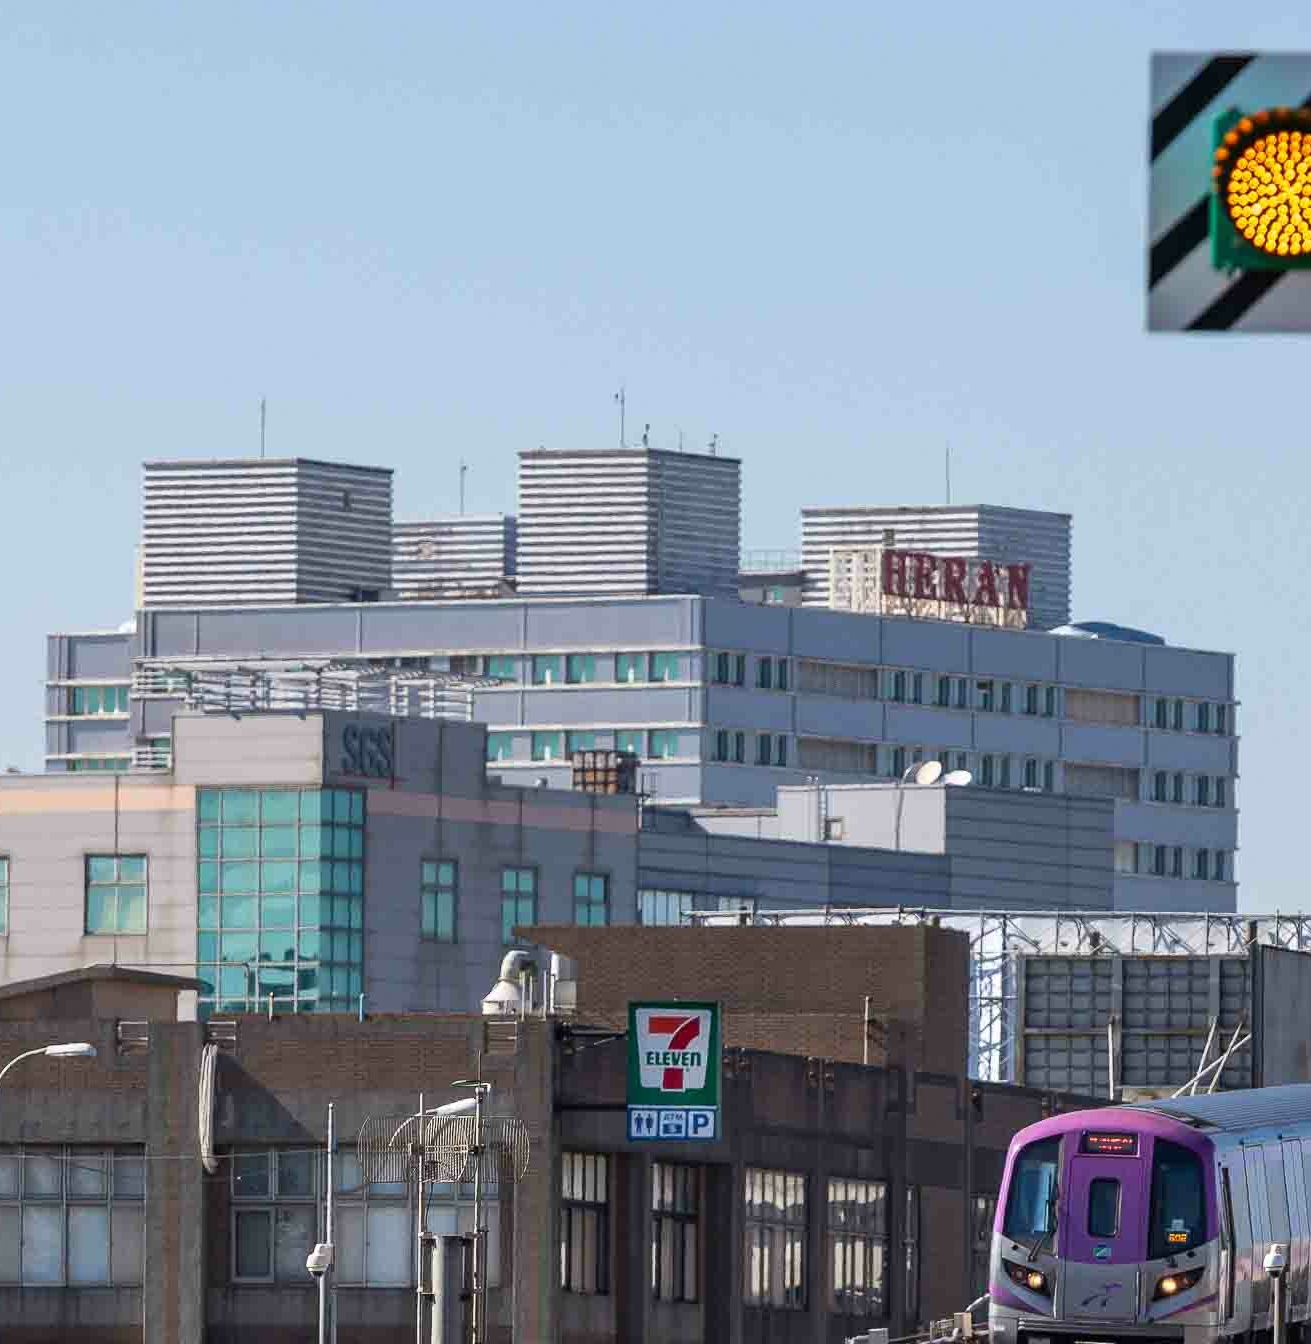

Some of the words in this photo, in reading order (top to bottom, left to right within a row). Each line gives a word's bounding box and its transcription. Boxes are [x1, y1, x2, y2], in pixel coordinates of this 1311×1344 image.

[882, 549, 1029, 609] HERAN
[342, 722, 392, 775] SGS
[648, 1015, 701, 1090] 7
[693, 1114, 710, 1134] P
